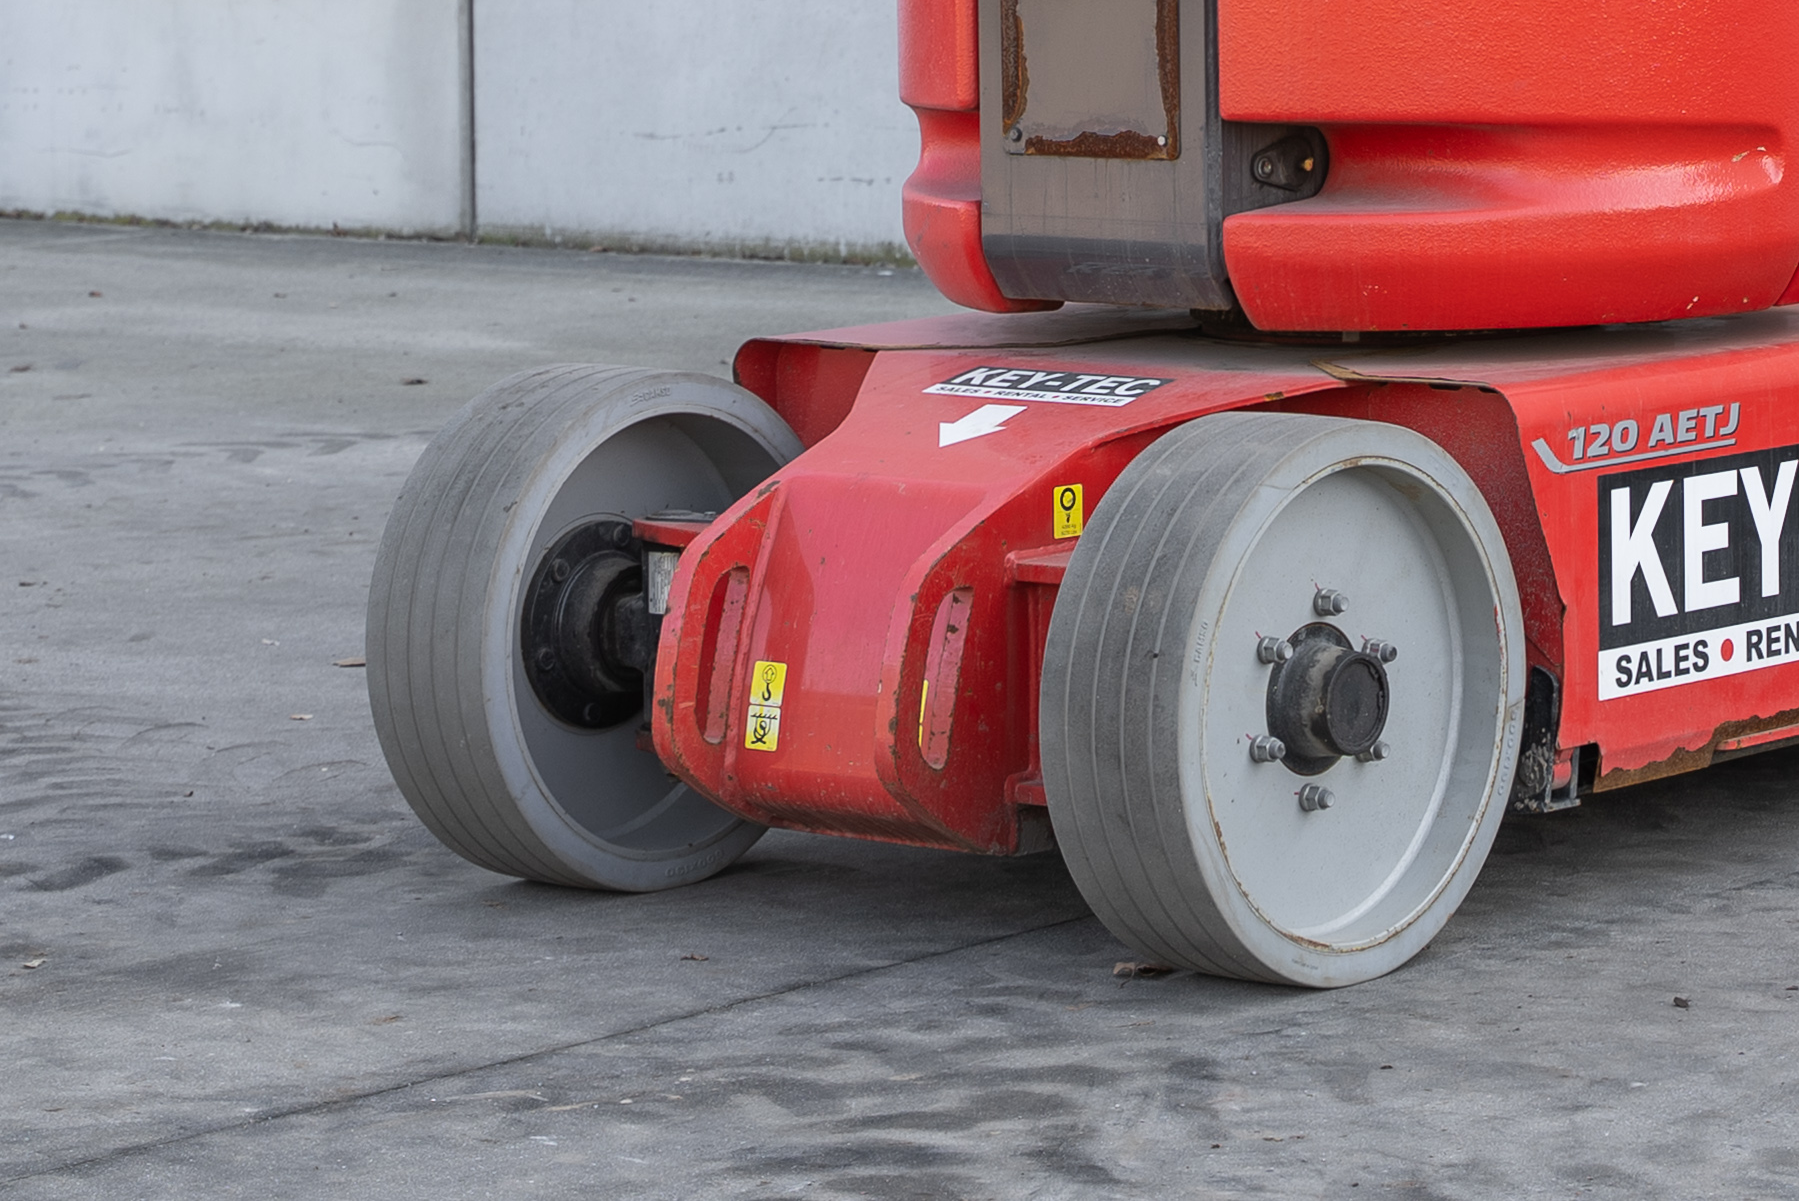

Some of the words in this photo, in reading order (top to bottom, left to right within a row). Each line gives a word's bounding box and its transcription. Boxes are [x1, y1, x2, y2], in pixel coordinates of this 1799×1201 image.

[936, 385, 981, 394] SALES
[994, 390, 1048, 399] RENTAL
[1062, 395, 1125, 404] SERVICE
[951, 367, 1161, 396] KEY-TEC
[1568, 419, 1639, 460] 120
[1648, 401, 1740, 449] AETJ
[1615, 639, 1710, 688] SALES
